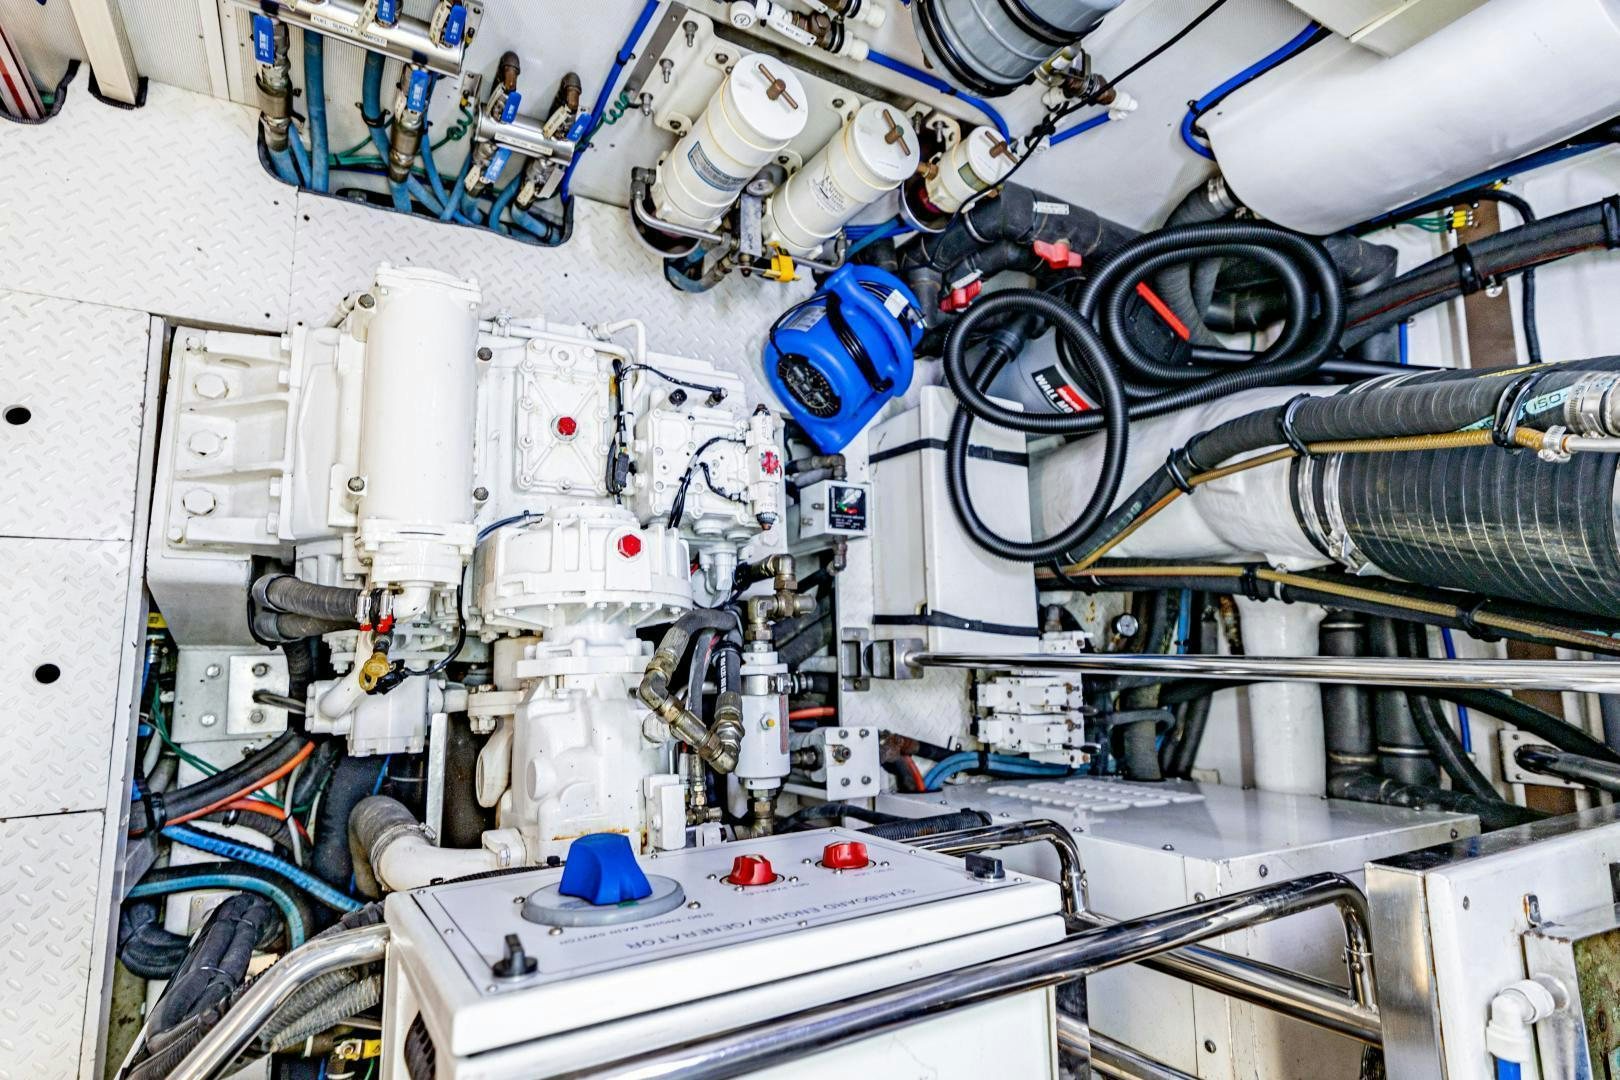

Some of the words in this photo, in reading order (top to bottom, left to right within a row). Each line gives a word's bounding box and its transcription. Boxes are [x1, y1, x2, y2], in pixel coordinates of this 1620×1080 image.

[1034, 374, 1059, 400] WALL
[823, 887, 916, 911] STARBOARD
[558, 932, 606, 946] SWITCH
